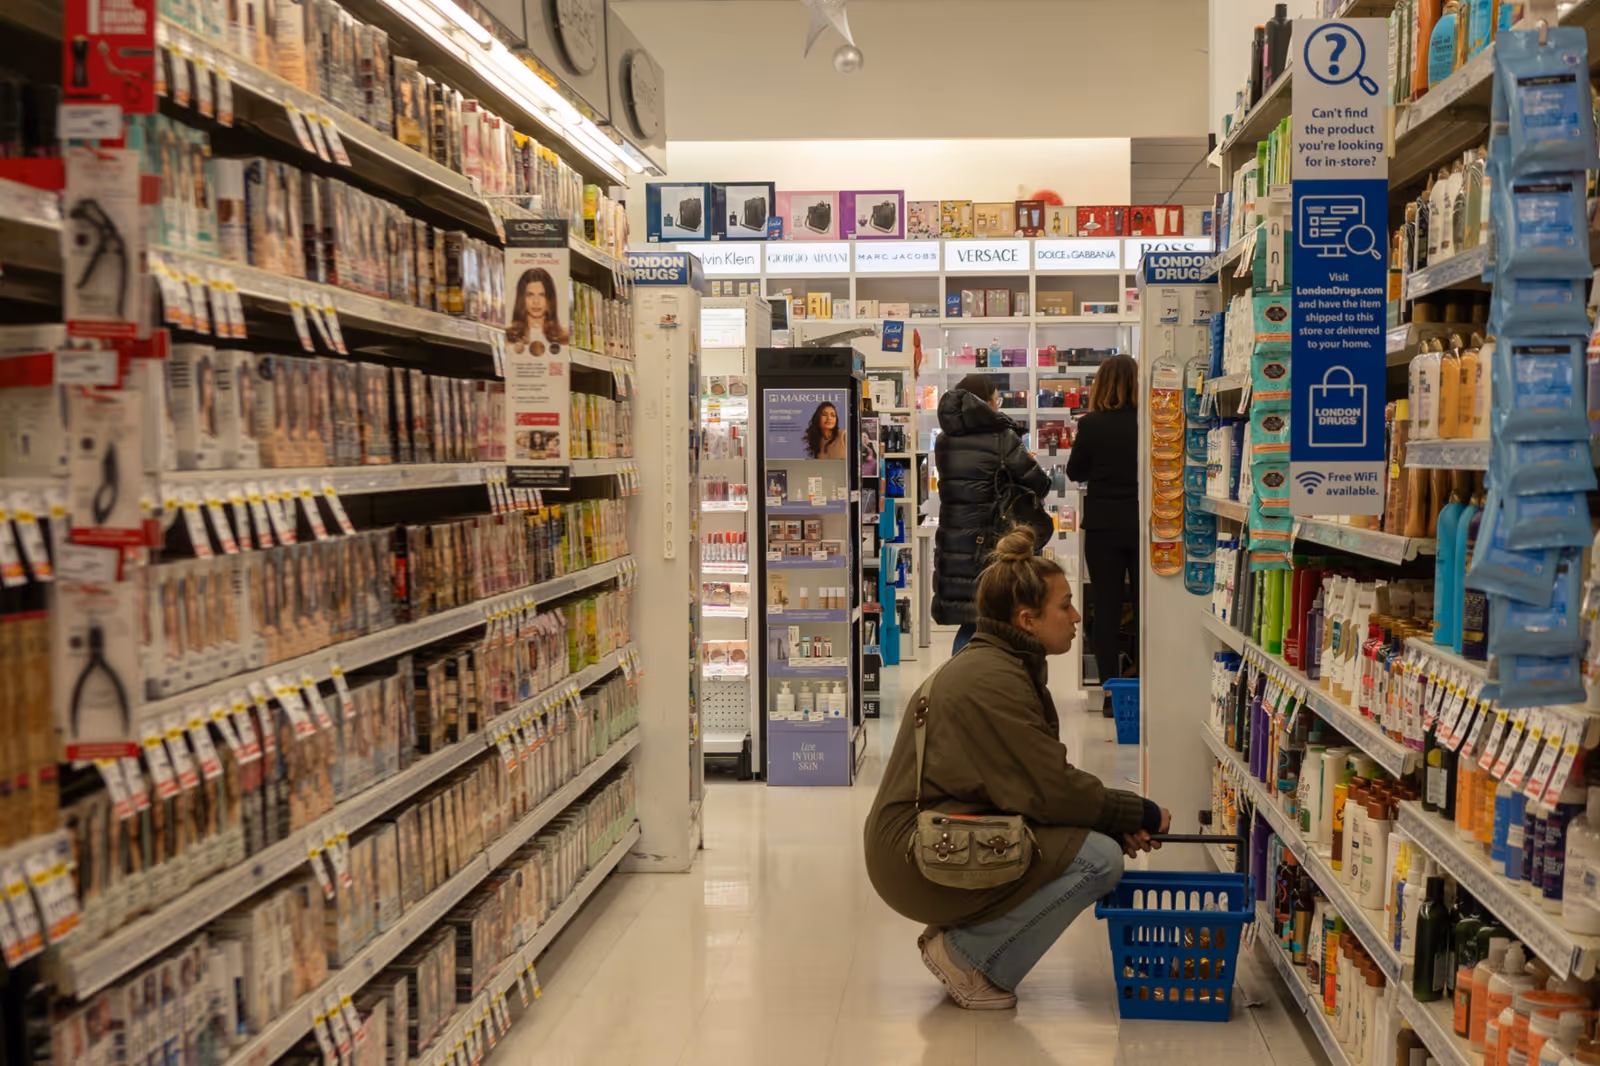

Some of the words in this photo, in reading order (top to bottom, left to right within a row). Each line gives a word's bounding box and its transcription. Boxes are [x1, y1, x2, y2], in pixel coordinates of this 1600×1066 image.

[1312, 108, 1342, 119] Can't
[1344, 108, 1368, 119] find
[1305, 124, 1325, 135] the
[1328, 124, 1374, 138] product
[1299, 141, 1336, 153] you're
[1338, 140, 1383, 153] looking
[1305, 157, 1322, 167] for
[1325, 157, 1377, 167] in-store?
[724, 252, 755, 266] Klein
[767, 253, 808, 263] GIORGIO
[812, 252, 848, 263] ARMANI
[891, 252, 937, 260] JACOBS
[957, 248, 1019, 263] VERSACE
[628, 256, 685, 268] ONDON
[634, 268, 680, 281] RUGS
[1329, 272, 1349, 282] Visit
[1296, 286, 1383, 297] LondonDrugs.com
[1298, 299, 1316, 309] and
[1318, 299, 1340, 309] have
[1342, 299, 1358, 309] the
[1360, 299, 1381, 309] item
[1305, 313, 1343, 323] shipped
[1344, 314, 1355, 322] to
[1356, 313, 1374, 322] this
[1299, 327, 1323, 335] store
[1336, 326, 1380, 335] delivered
[1307, 340, 1318, 349] to
[1319, 341, 1341, 350] your
[1342, 340, 1372, 349] home.
[1315, 408, 1361, 417] LONDON
[1318, 416, 1358, 425] DRUGS
[1328, 472, 1352, 482] Free
[1354, 472, 1378, 482] WiFi
[1326, 486, 1379, 496] available.
[792, 752, 801, 761] IN
[802, 752, 824, 761] YOUR
[798, 762, 818, 771] SKIN
